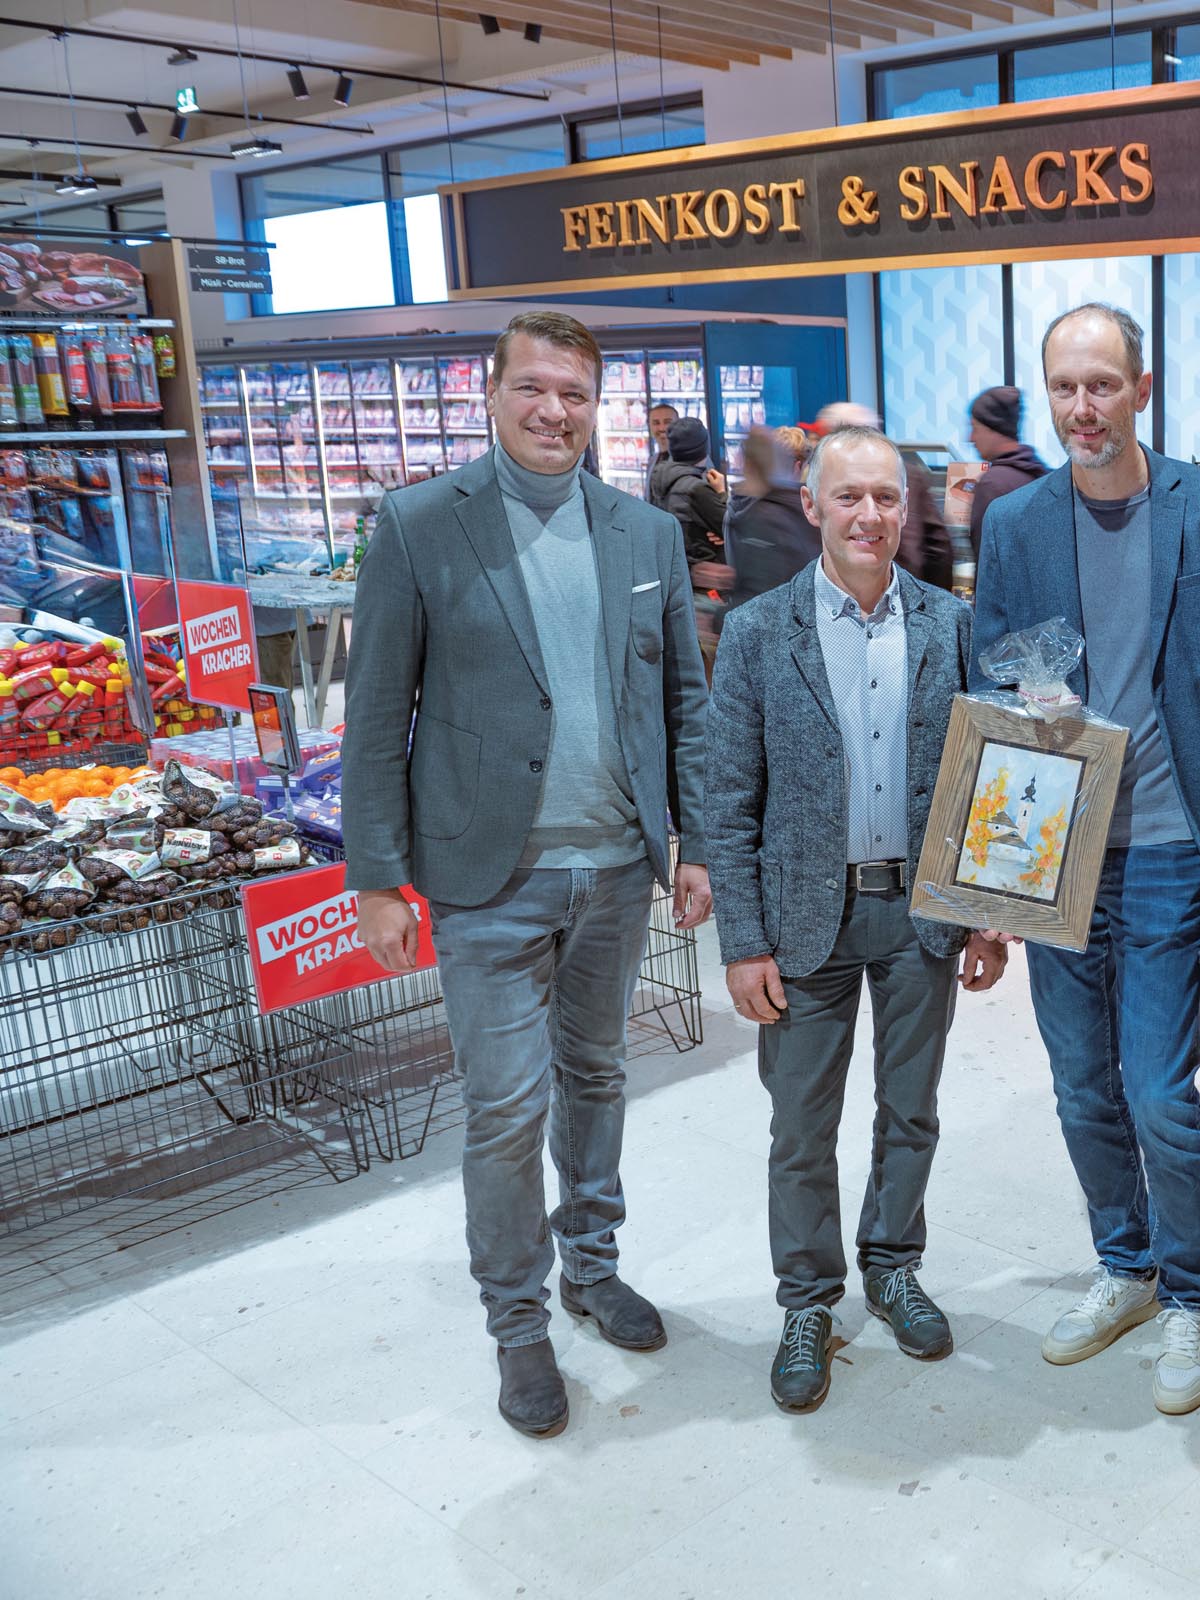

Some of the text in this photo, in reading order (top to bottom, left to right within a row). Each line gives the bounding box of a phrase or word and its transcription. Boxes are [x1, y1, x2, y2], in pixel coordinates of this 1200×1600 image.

[560, 142, 1154, 252] FEINKOST & SNACKS
[214, 255, 246, 266] SB-Brot
[200, 278, 222, 288] Müsli
[226, 279, 265, 289] Cerealien
[190, 614, 238, 647] WOCHEN
[201, 643, 251, 676] KRACHER
[266, 895, 359, 951] WOCH
